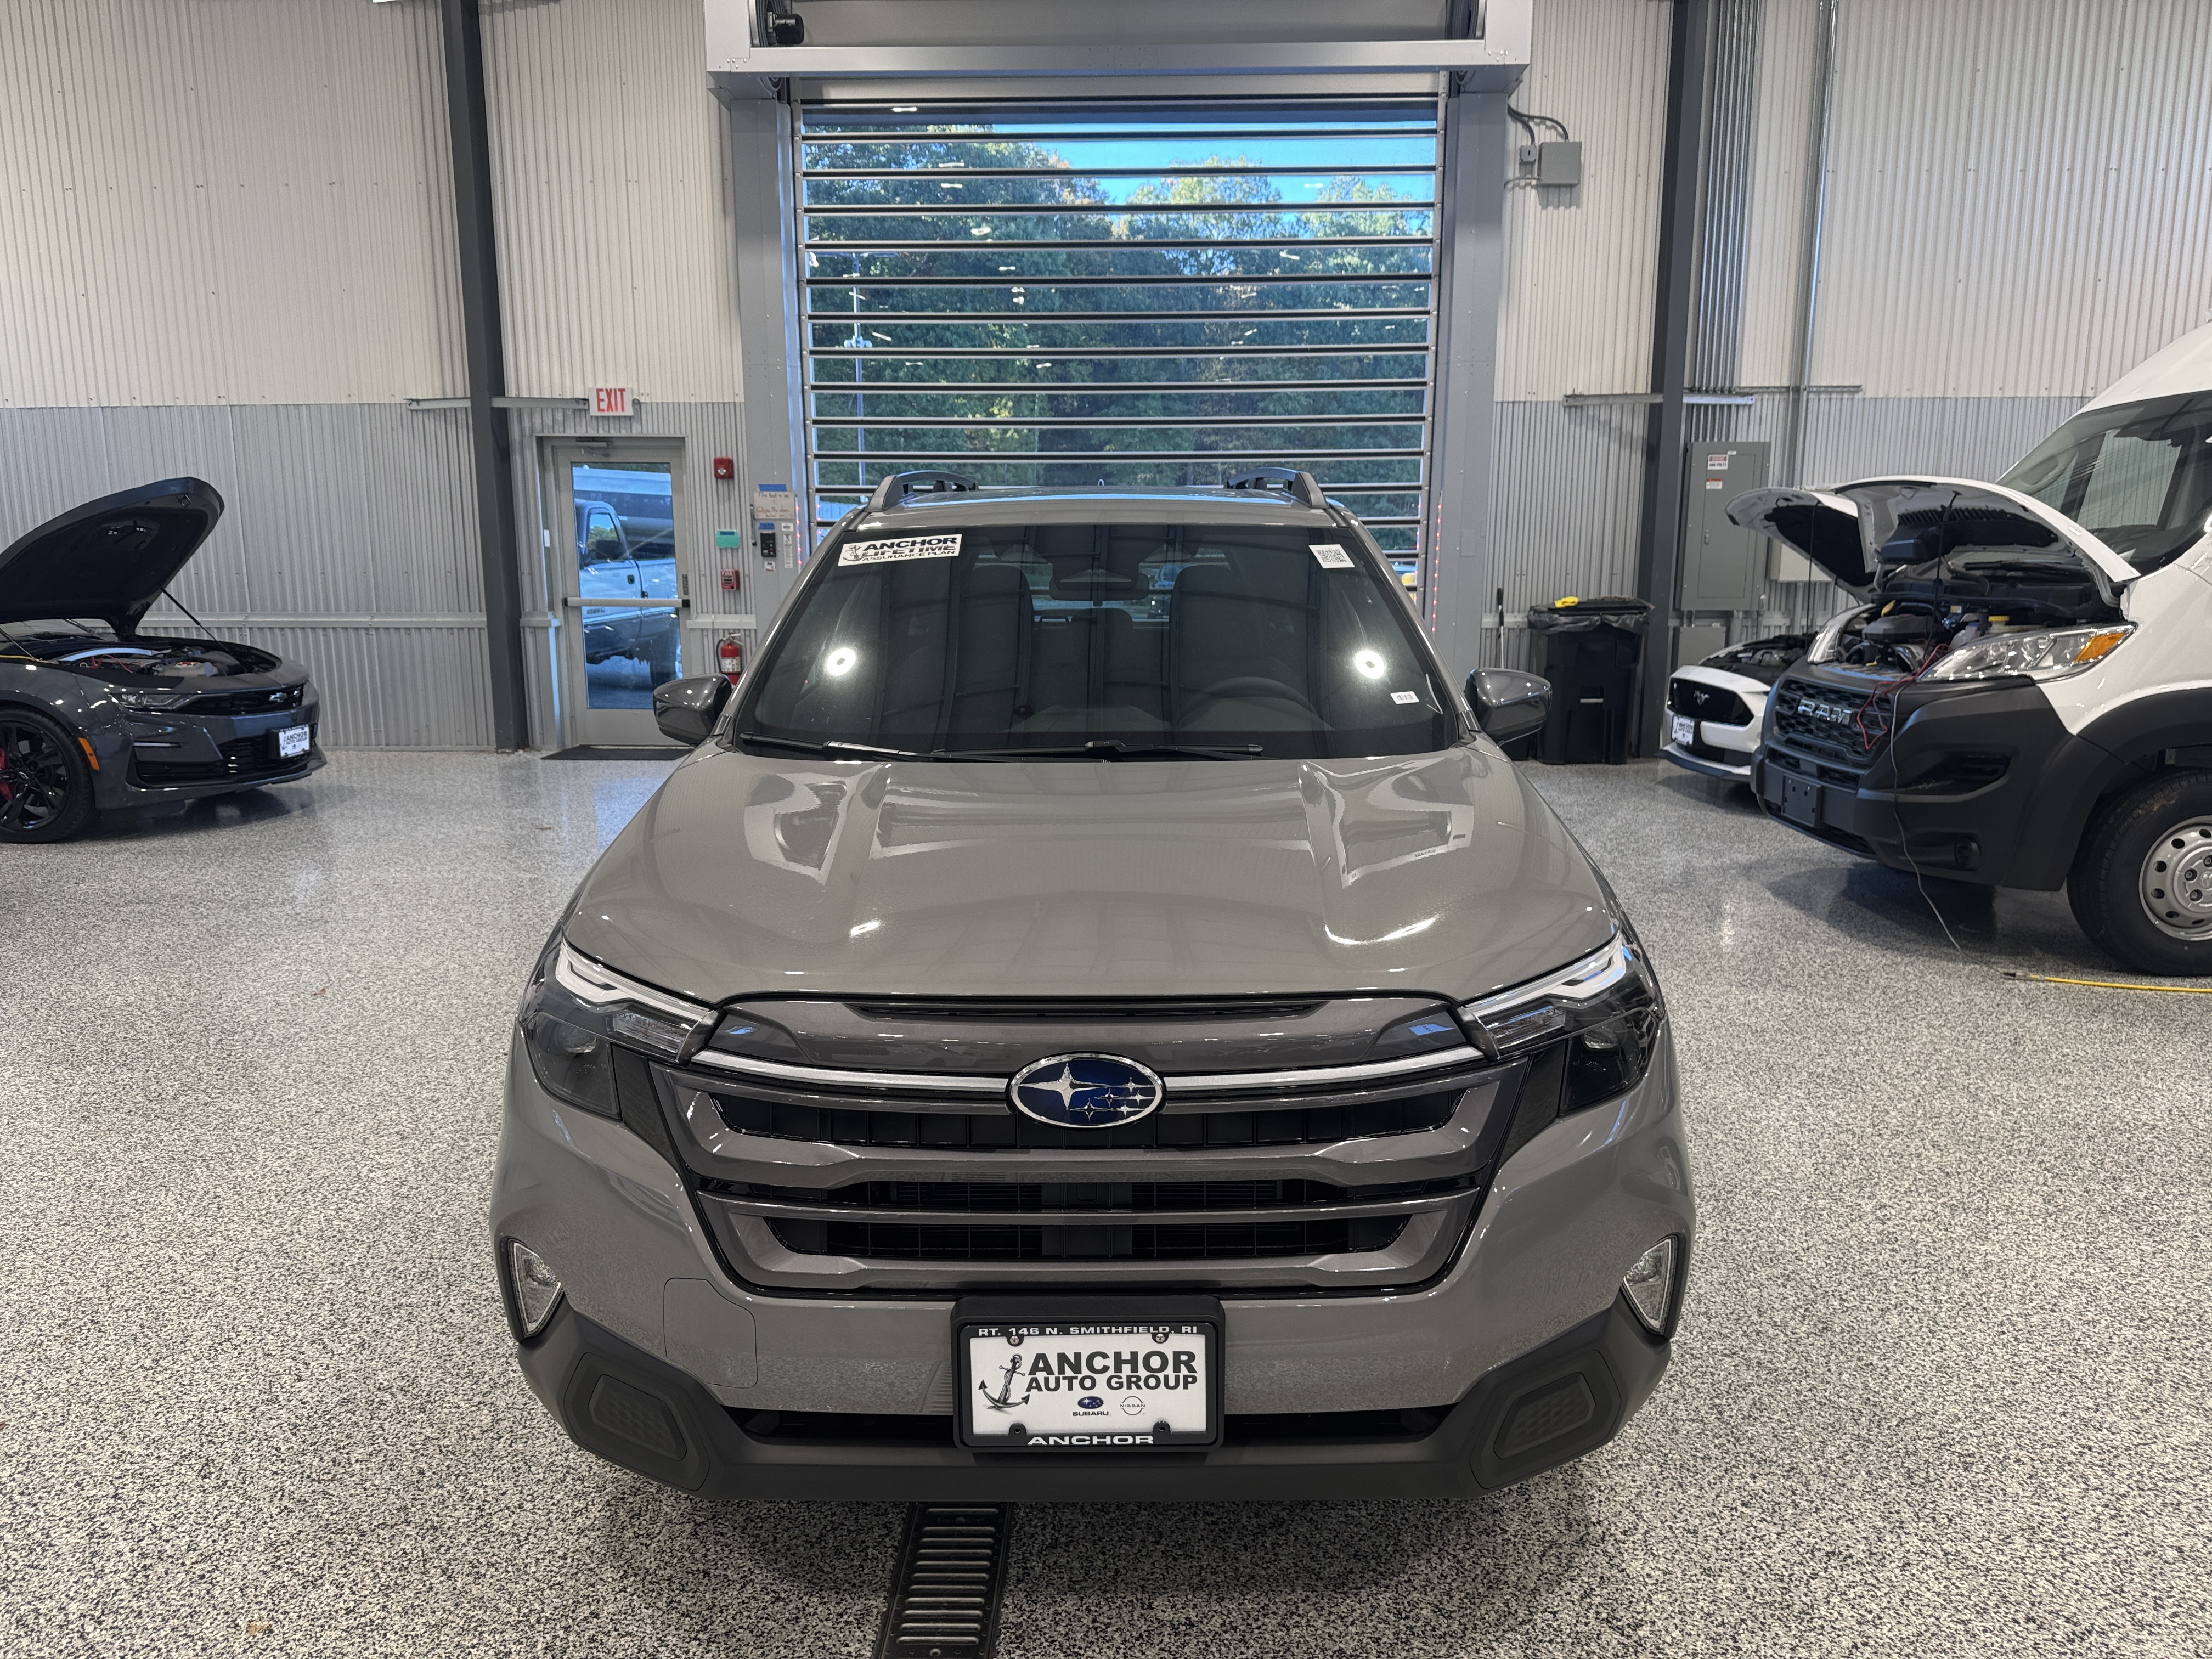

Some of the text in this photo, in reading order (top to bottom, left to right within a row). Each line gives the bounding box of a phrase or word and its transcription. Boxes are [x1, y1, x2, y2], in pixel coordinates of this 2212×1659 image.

[596, 388, 625, 413] EXIT
[861, 544, 957, 557] LIFETIME
[863, 537, 958, 551] ANCHOR
[862, 552, 926, 562] ASSURANCE
[1798, 697, 1853, 725] RAM
[286, 731, 307, 740] ANCHOR
[1008, 1327, 1039, 1335] 146
[1069, 1325, 1175, 1334] SMITHFIELD,
[1028, 1350, 1198, 1375] ANCHOR
[1025, 1374, 1198, 1392] AUTO GROUP
[1027, 1435, 1153, 1446] ANCHOR
